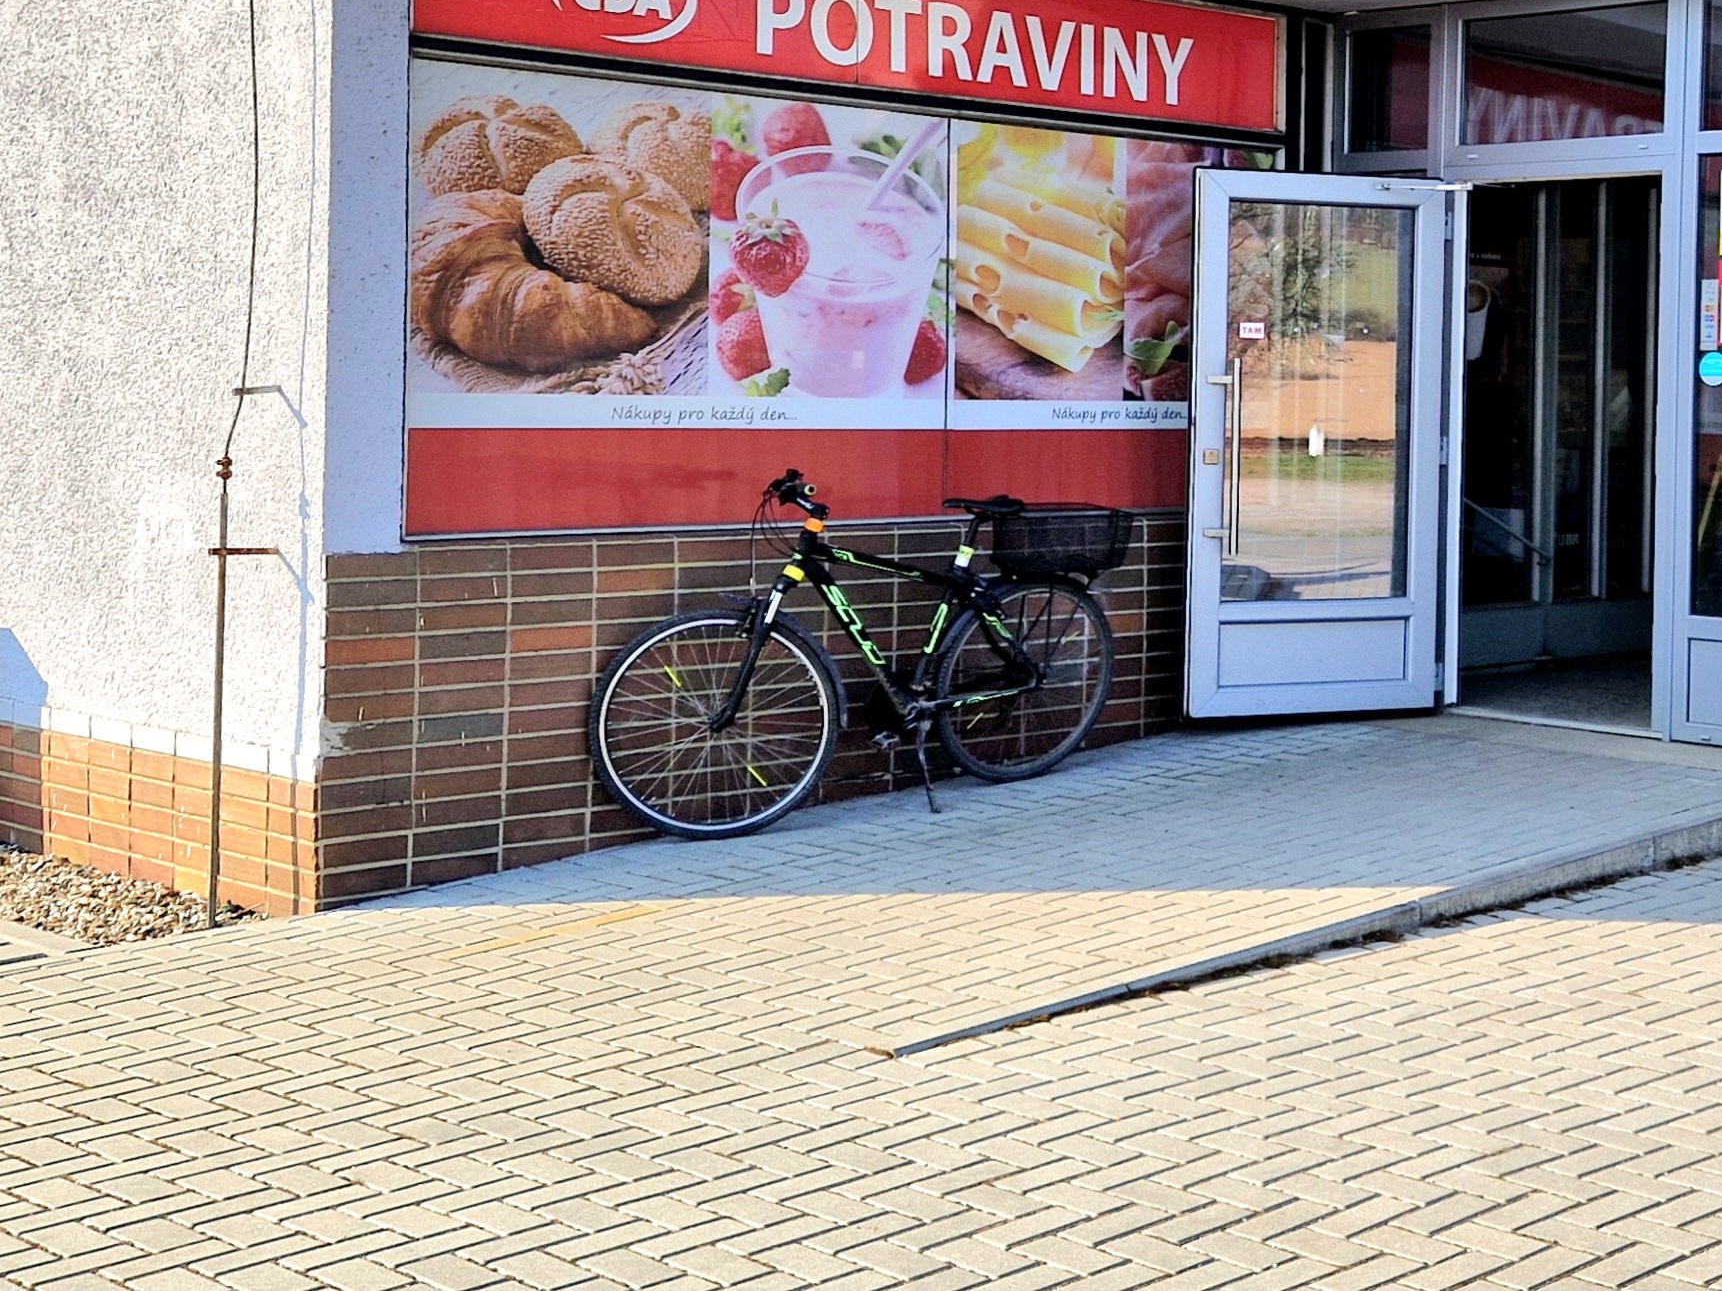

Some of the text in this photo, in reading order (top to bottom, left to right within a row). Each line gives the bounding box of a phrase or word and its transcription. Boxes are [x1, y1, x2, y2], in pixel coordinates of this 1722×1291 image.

[1242, 326, 1262, 334] TAM
[611, 405, 671, 424] Nákupy
[678, 409, 705, 424] pro
[711, 406, 754, 424] každý
[1052, 407, 1096, 423] Nákupy
[1100, 410, 1121, 423] pro
[1125, 407, 1158, 423] každý
